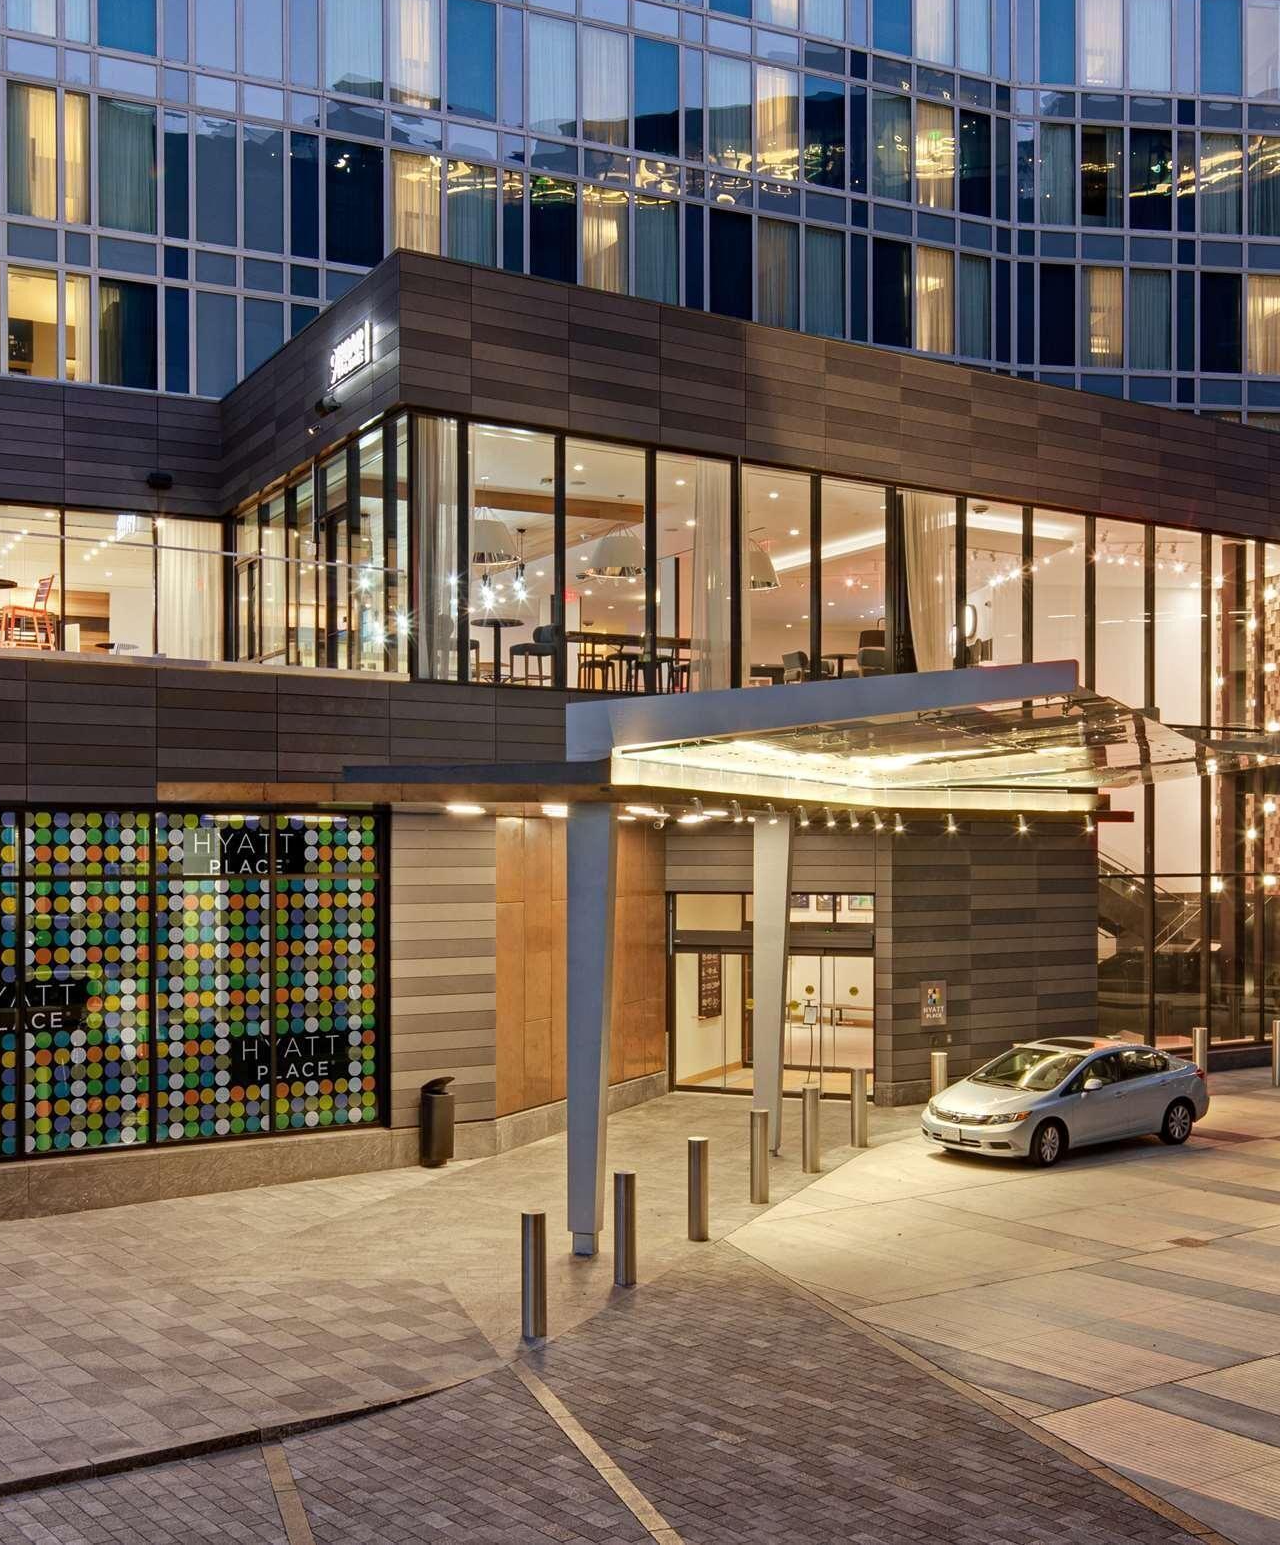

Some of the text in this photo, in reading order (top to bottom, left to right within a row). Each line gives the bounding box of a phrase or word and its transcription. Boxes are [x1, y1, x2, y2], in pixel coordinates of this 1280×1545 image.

[194, 833, 294, 854] HYATT
[923, 1006, 944, 1015] HYATT
[257, 1061, 329, 1080] PACE
